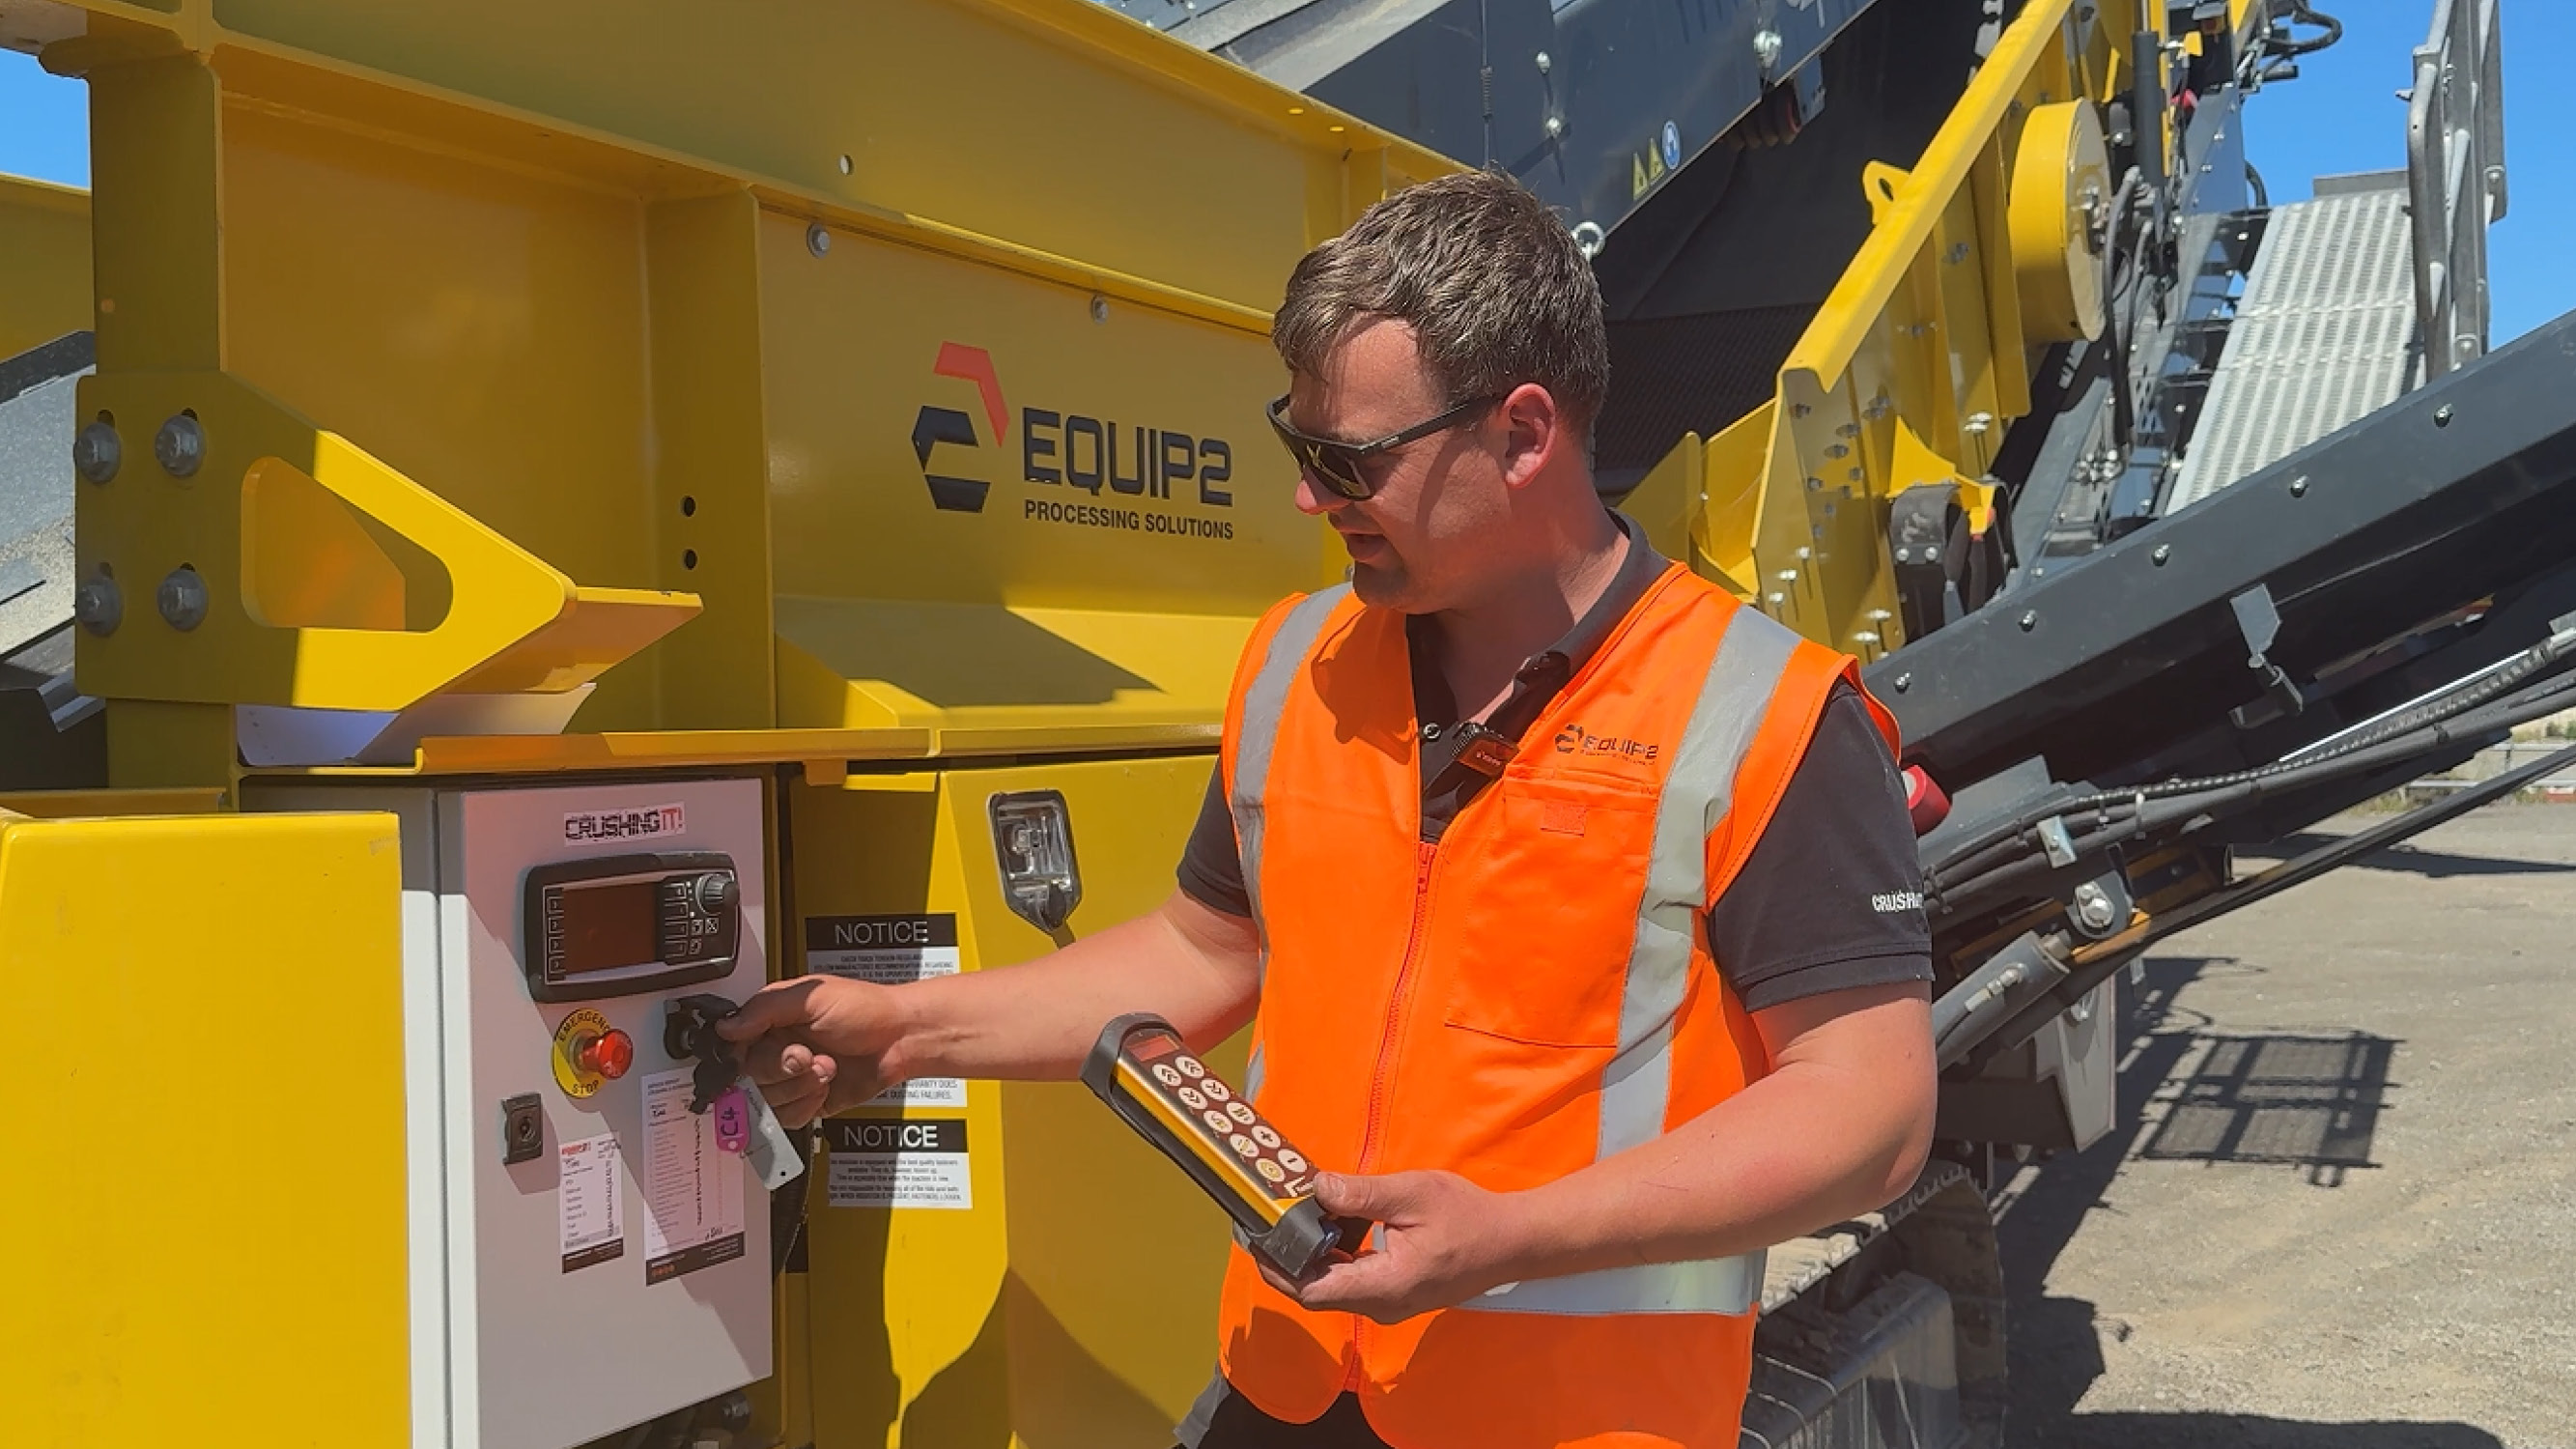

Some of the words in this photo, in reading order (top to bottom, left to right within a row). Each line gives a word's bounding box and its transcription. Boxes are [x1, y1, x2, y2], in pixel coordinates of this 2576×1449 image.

[1022, 406, 1233, 507] EQUIP2
[1024, 498, 1140, 531] PROCESSING
[1145, 512, 1233, 540] SOLUTIONS
[834, 921, 929, 945] NOTICE
[557, 1010, 610, 1042] EMERGEN
[573, 1079, 600, 1094] STOP
[843, 1124, 939, 1148] NOTICE
